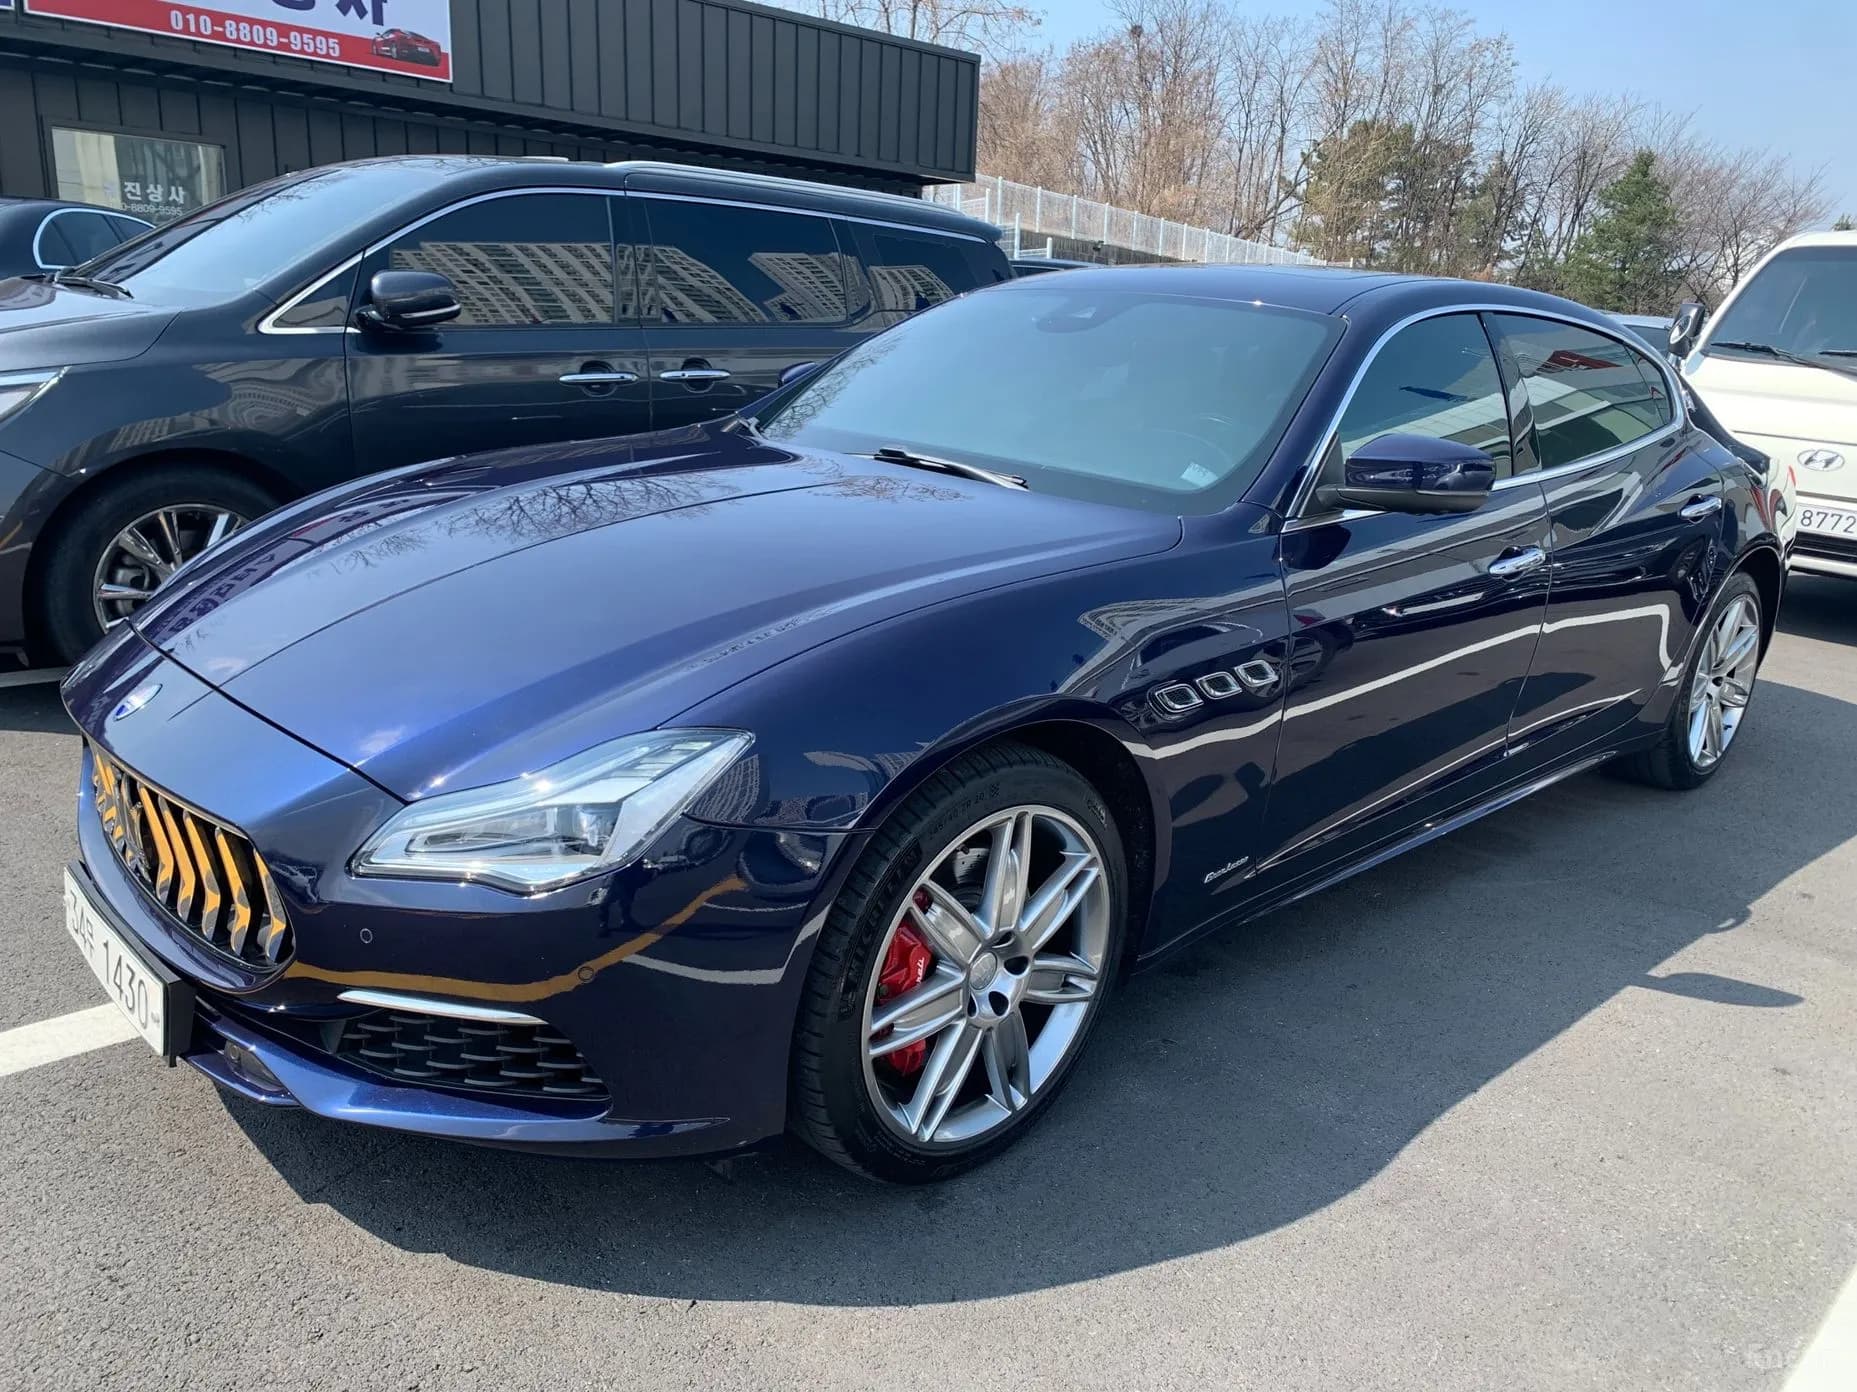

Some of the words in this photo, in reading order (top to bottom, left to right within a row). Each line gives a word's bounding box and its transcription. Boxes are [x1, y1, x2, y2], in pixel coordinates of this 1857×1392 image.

[170, 10, 341, 57] 010-8809-9595
[1800, 509, 1857, 534] 8772
[102, 939, 149, 1030] 1430
